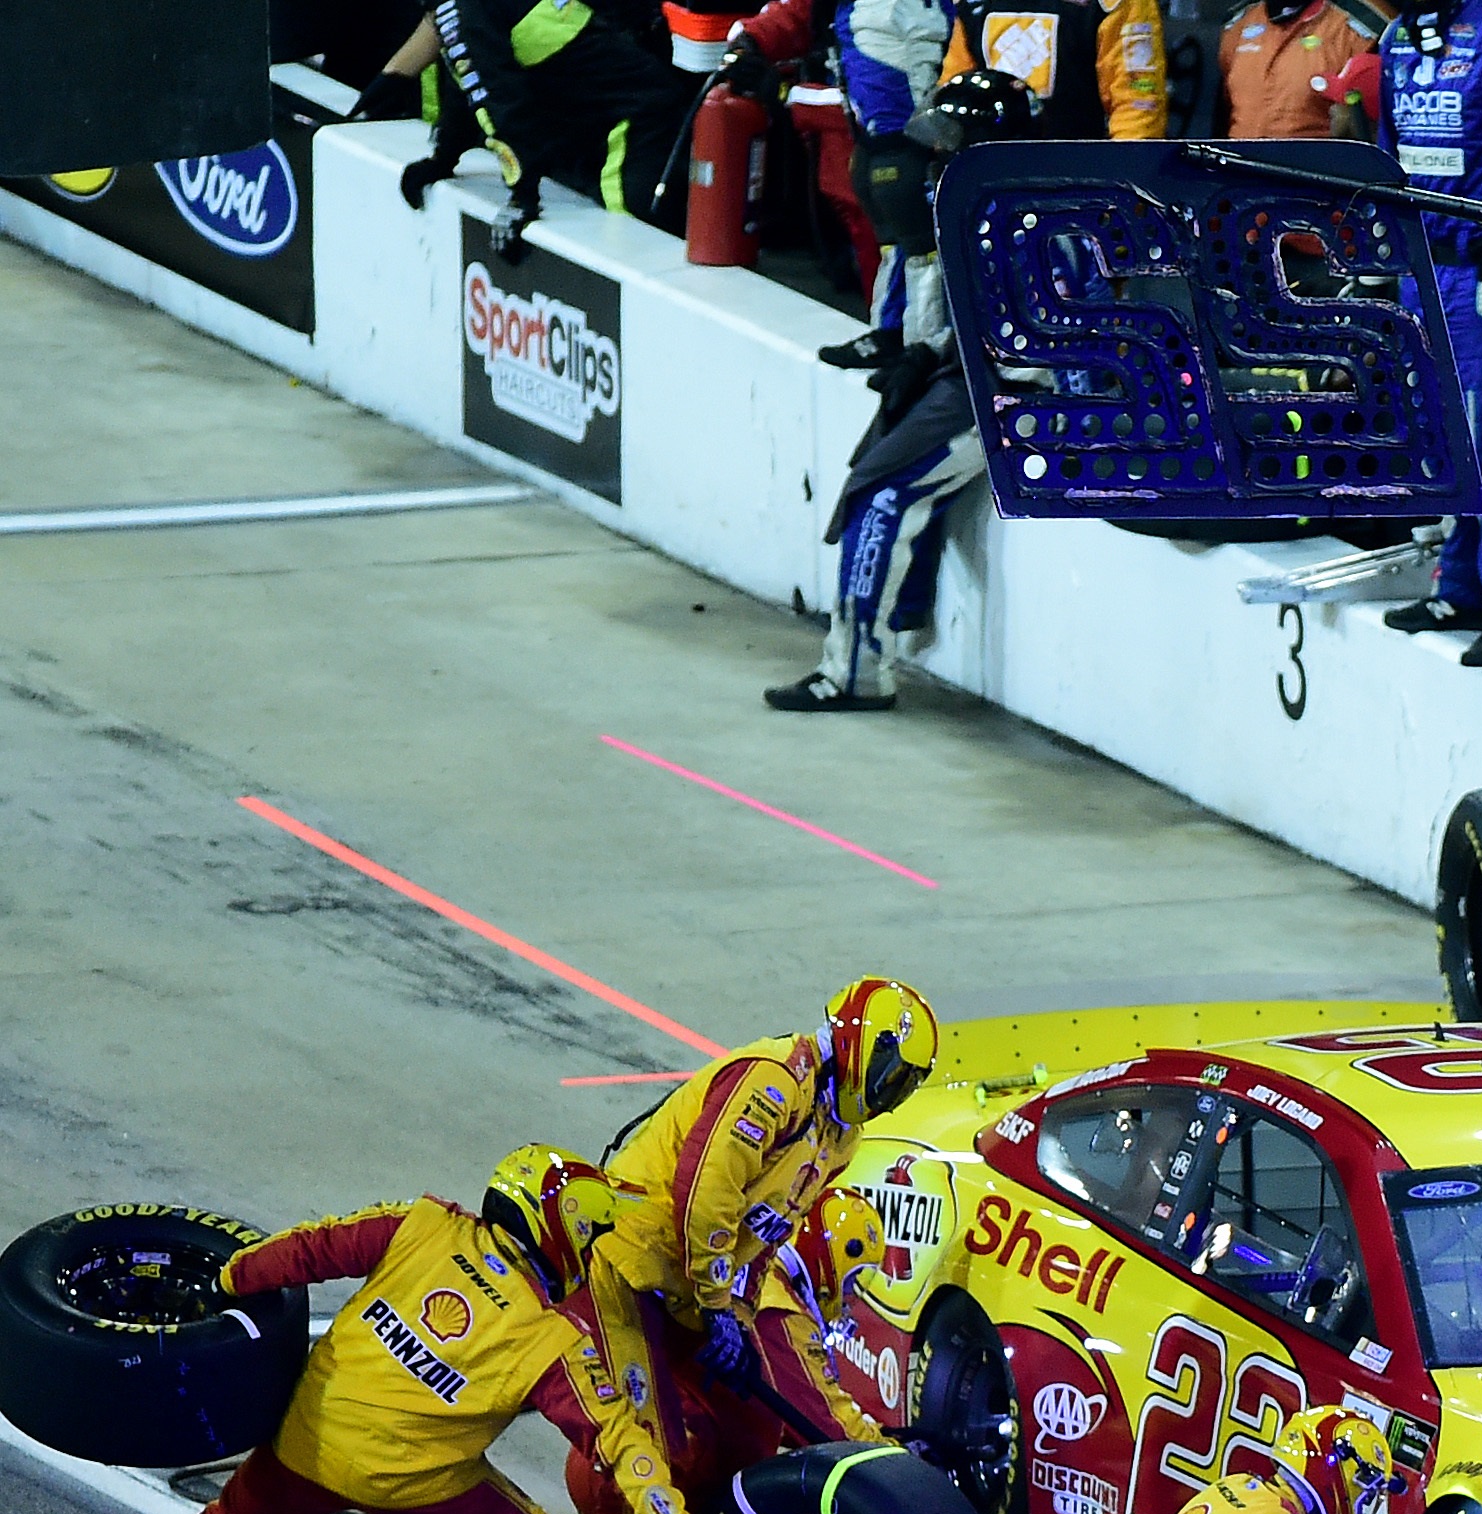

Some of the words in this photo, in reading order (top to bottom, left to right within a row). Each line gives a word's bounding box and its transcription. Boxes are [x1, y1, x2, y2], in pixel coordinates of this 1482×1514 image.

[1393, 91, 1463, 113] JACOB
[469, 276, 614, 401] SportClips
[498, 367, 579, 420] HAIRCUTS
[1276, 604, 1305, 718] 3
[994, 1111, 1035, 1144] SKF
[852, 1186, 944, 1246] NNZOIL
[1420, 1183, 1470, 1198] Ford
[75, 1203, 264, 1244] GOODYEAR
[451, 1253, 511, 1312] DOWELL
[964, 1195, 1126, 1315] Shell
[361, 1298, 468, 1405] PENNZOIL
[1041, 1385, 1088, 1438] AAA
